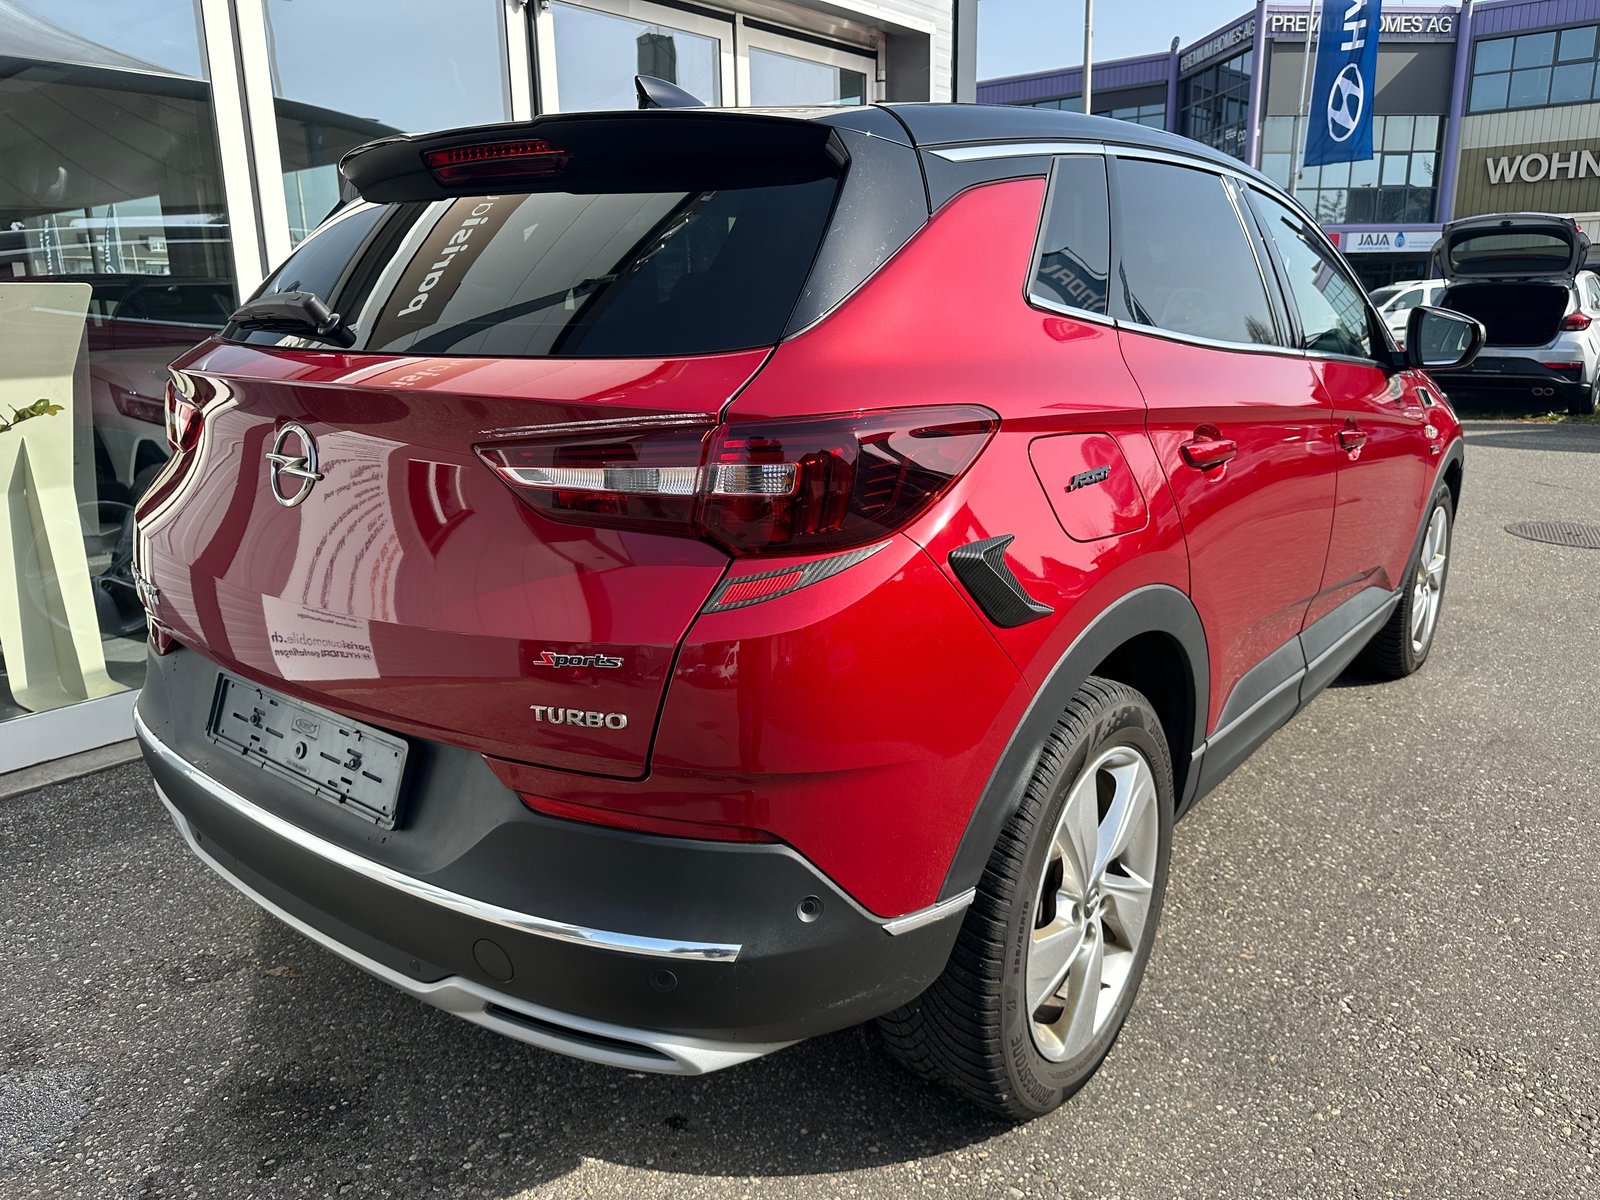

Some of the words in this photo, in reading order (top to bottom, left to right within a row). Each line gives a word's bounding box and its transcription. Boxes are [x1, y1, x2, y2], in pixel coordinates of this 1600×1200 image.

[1213, 26, 1242, 54] HOMES
[1242, 19, 1256, 40] AG
[1426, 16, 1453, 32] AG
[1486, 149, 1600, 185] WOHN
[1358, 233, 1390, 246] JAJA
[533, 650, 624, 668] Sports
[530, 704, 628, 730] TURBO
[1011, 1033, 1057, 1107] BRIDGESTONE
